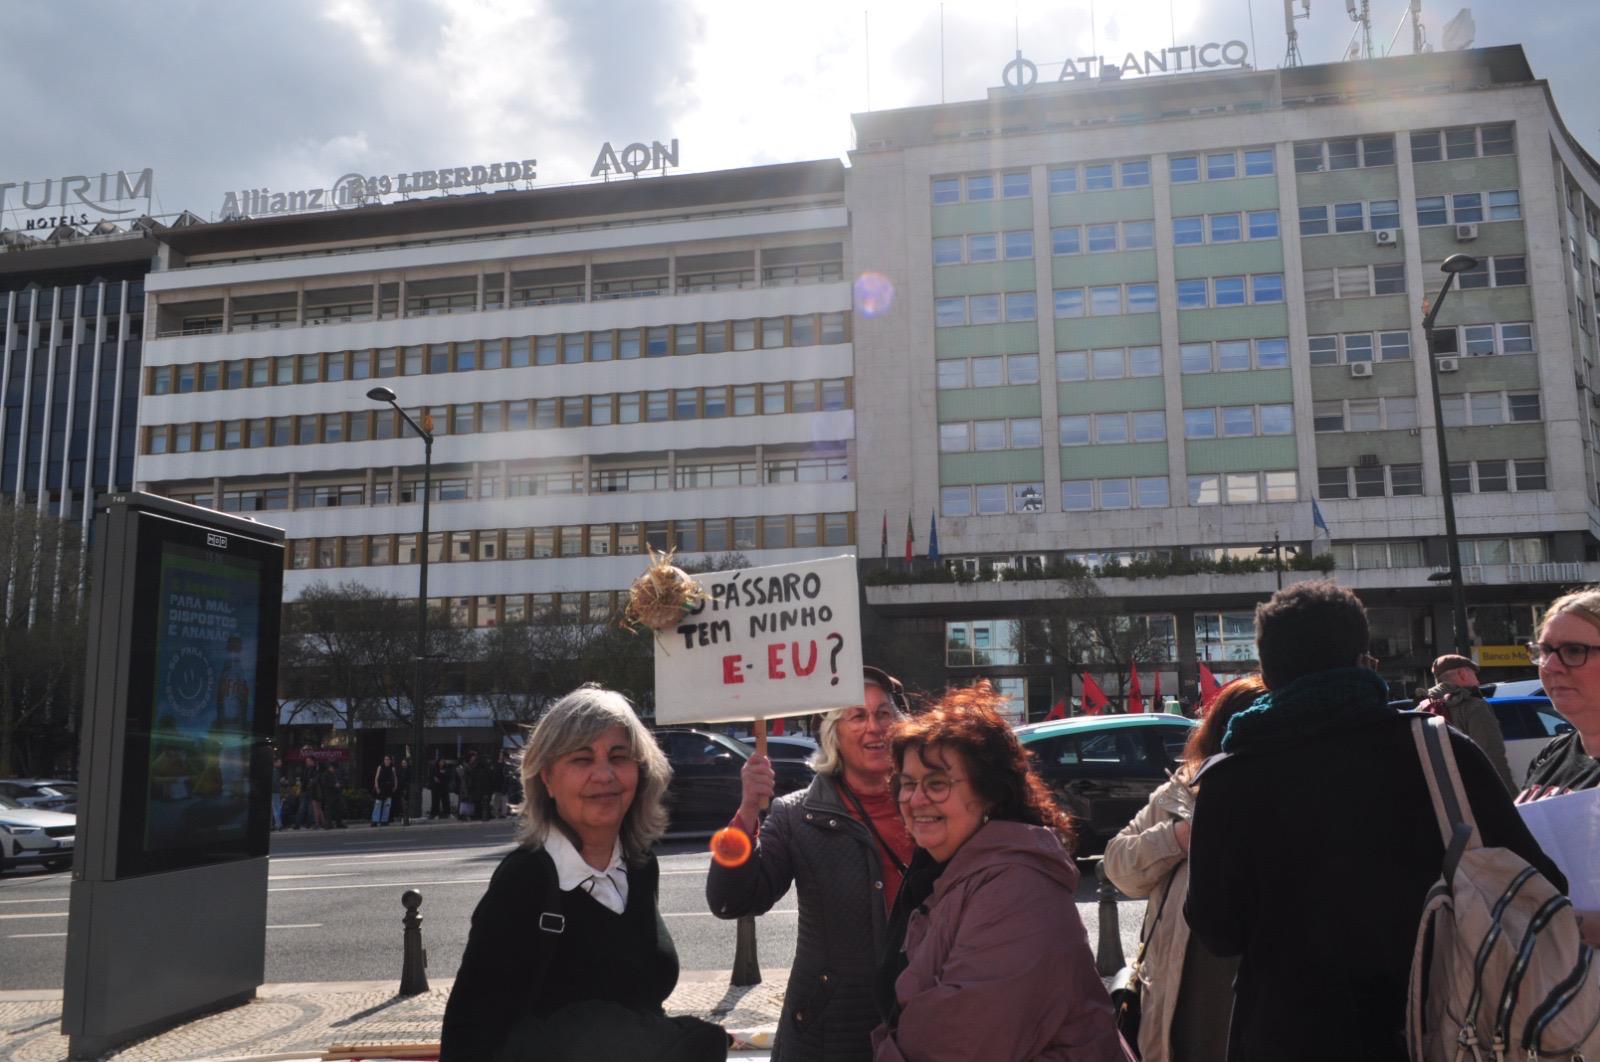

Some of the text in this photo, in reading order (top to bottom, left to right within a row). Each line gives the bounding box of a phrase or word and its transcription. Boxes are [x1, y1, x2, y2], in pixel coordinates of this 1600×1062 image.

[1058, 40, 1248, 82] ATLANTICO
[590, 138, 679, 177] AON
[0, 167, 153, 214] TURIM
[397, 159, 537, 194] LIBERDADE
[220, 187, 324, 218] Allianz
[26, 213, 89, 230] HOTELS
[169, 594, 202, 610] PARA
[711, 572, 821, 612] PÁSSARO
[169, 609, 238, 628] DISPOSTOS
[677, 605, 833, 649] TEM NINHO
